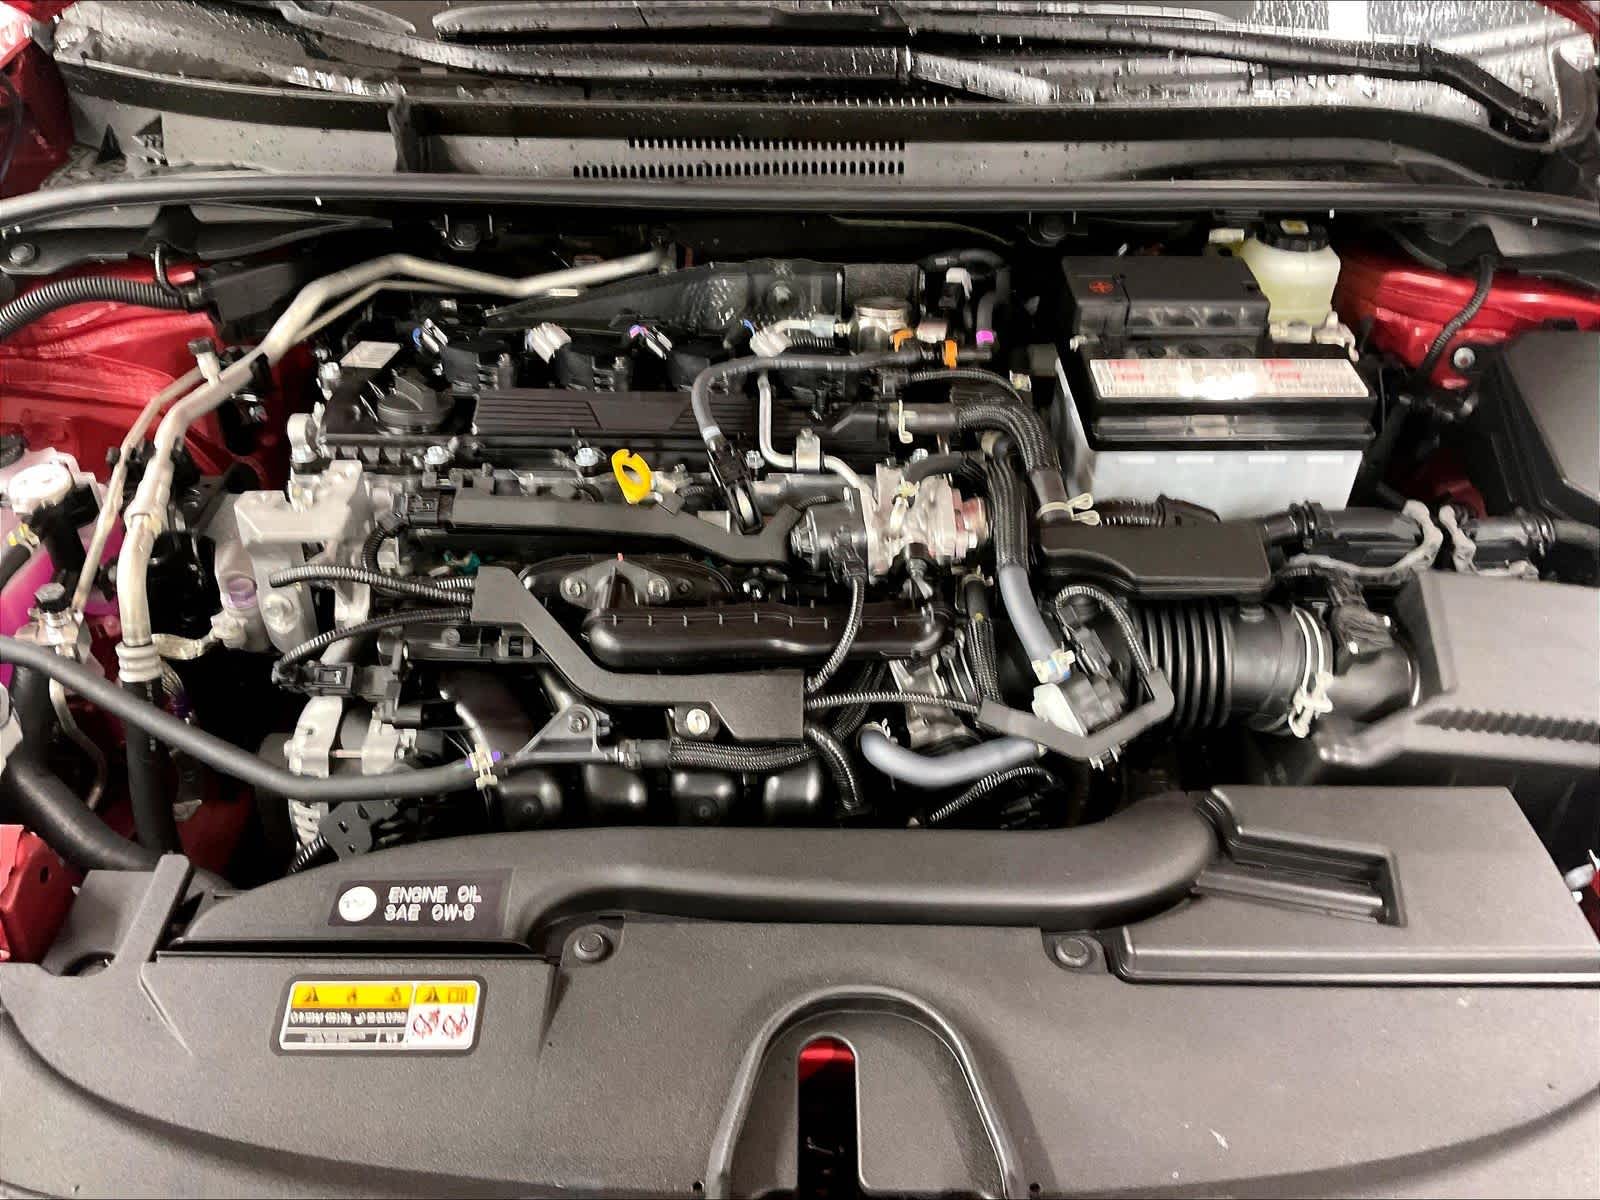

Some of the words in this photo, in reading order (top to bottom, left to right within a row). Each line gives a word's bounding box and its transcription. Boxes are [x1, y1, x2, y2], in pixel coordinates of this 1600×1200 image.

[388, 885, 448, 903] ENGINE
[457, 885, 482, 903] OIL
[384, 904, 421, 921] SAE
